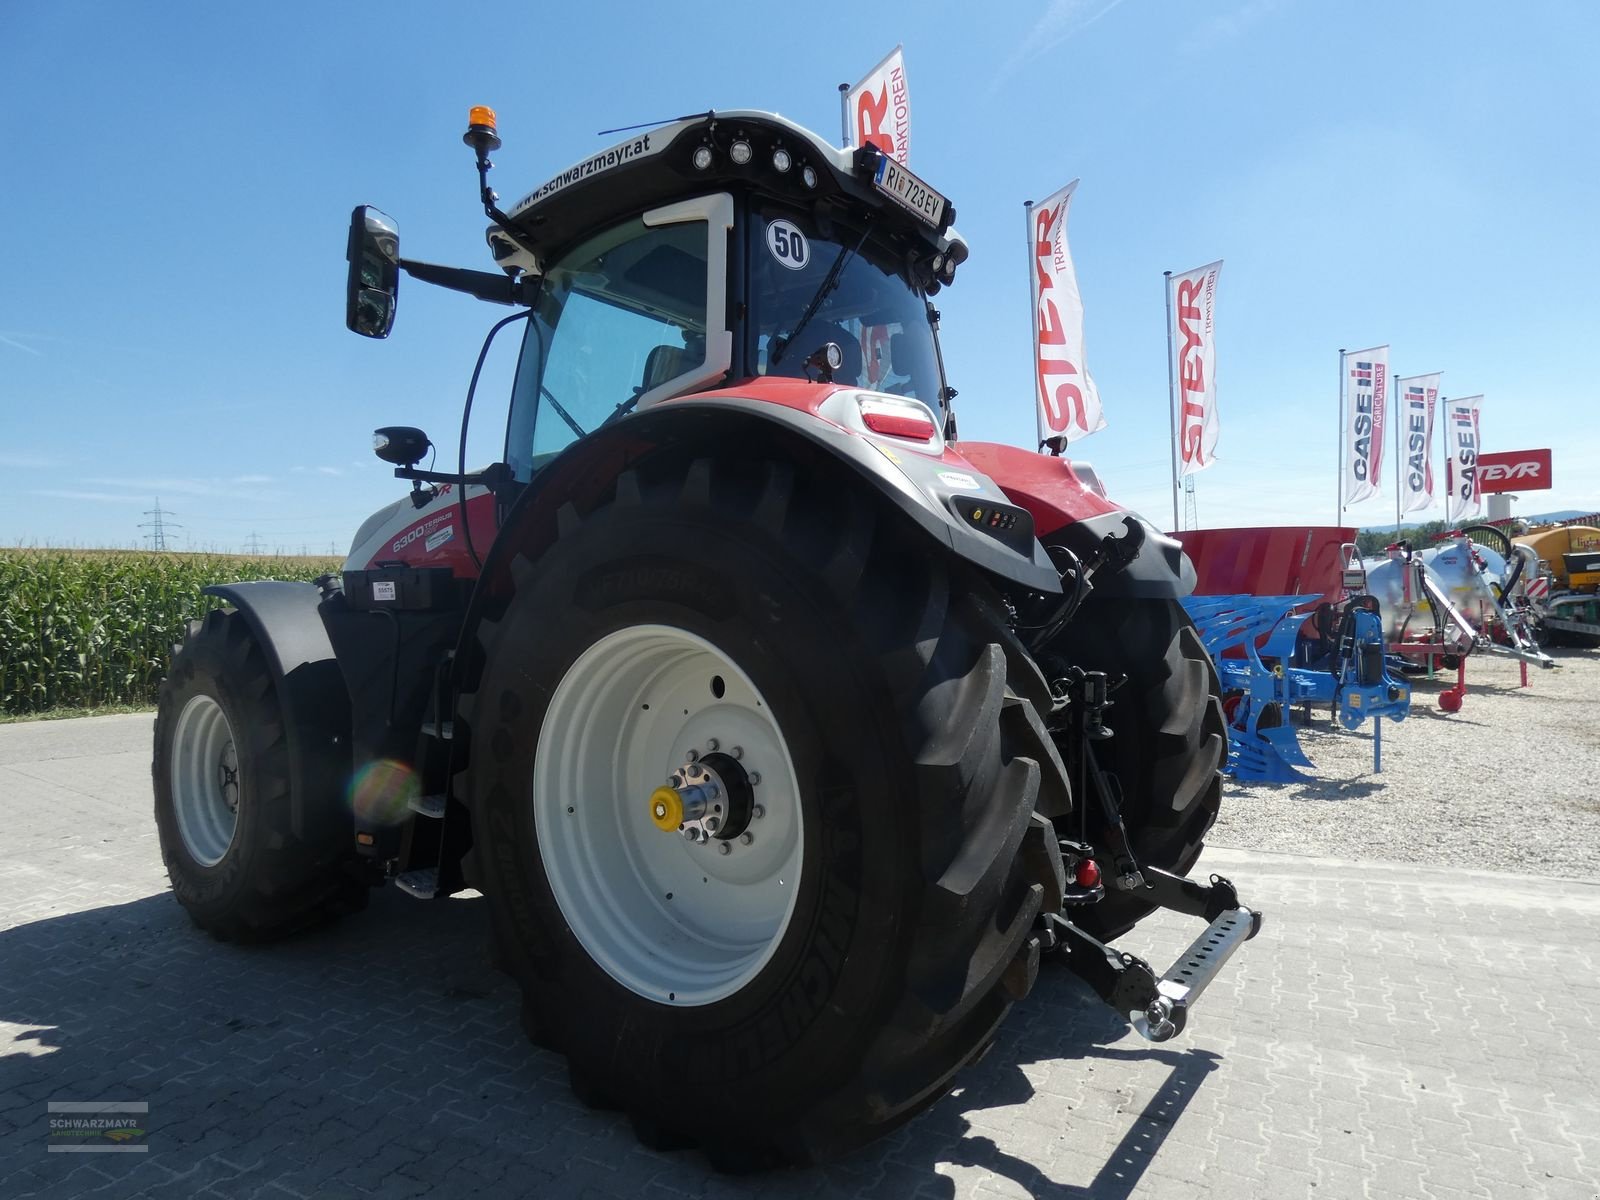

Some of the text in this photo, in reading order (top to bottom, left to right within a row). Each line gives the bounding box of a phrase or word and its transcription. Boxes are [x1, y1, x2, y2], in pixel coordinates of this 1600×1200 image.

[891, 66, 908, 164] RAKTOREN
[904, 179, 926, 209] 723
[773, 225, 804, 263] 50
[1176, 275, 1206, 467] STEYR
[1373, 366, 1385, 428] AGRICULTURE
[1353, 393, 1372, 482] CASE
[1408, 414, 1425, 492] CASE
[1457, 432, 1476, 501] CASE
[1477, 461, 1541, 481] TEYR
[393, 525, 424, 553] 6300
